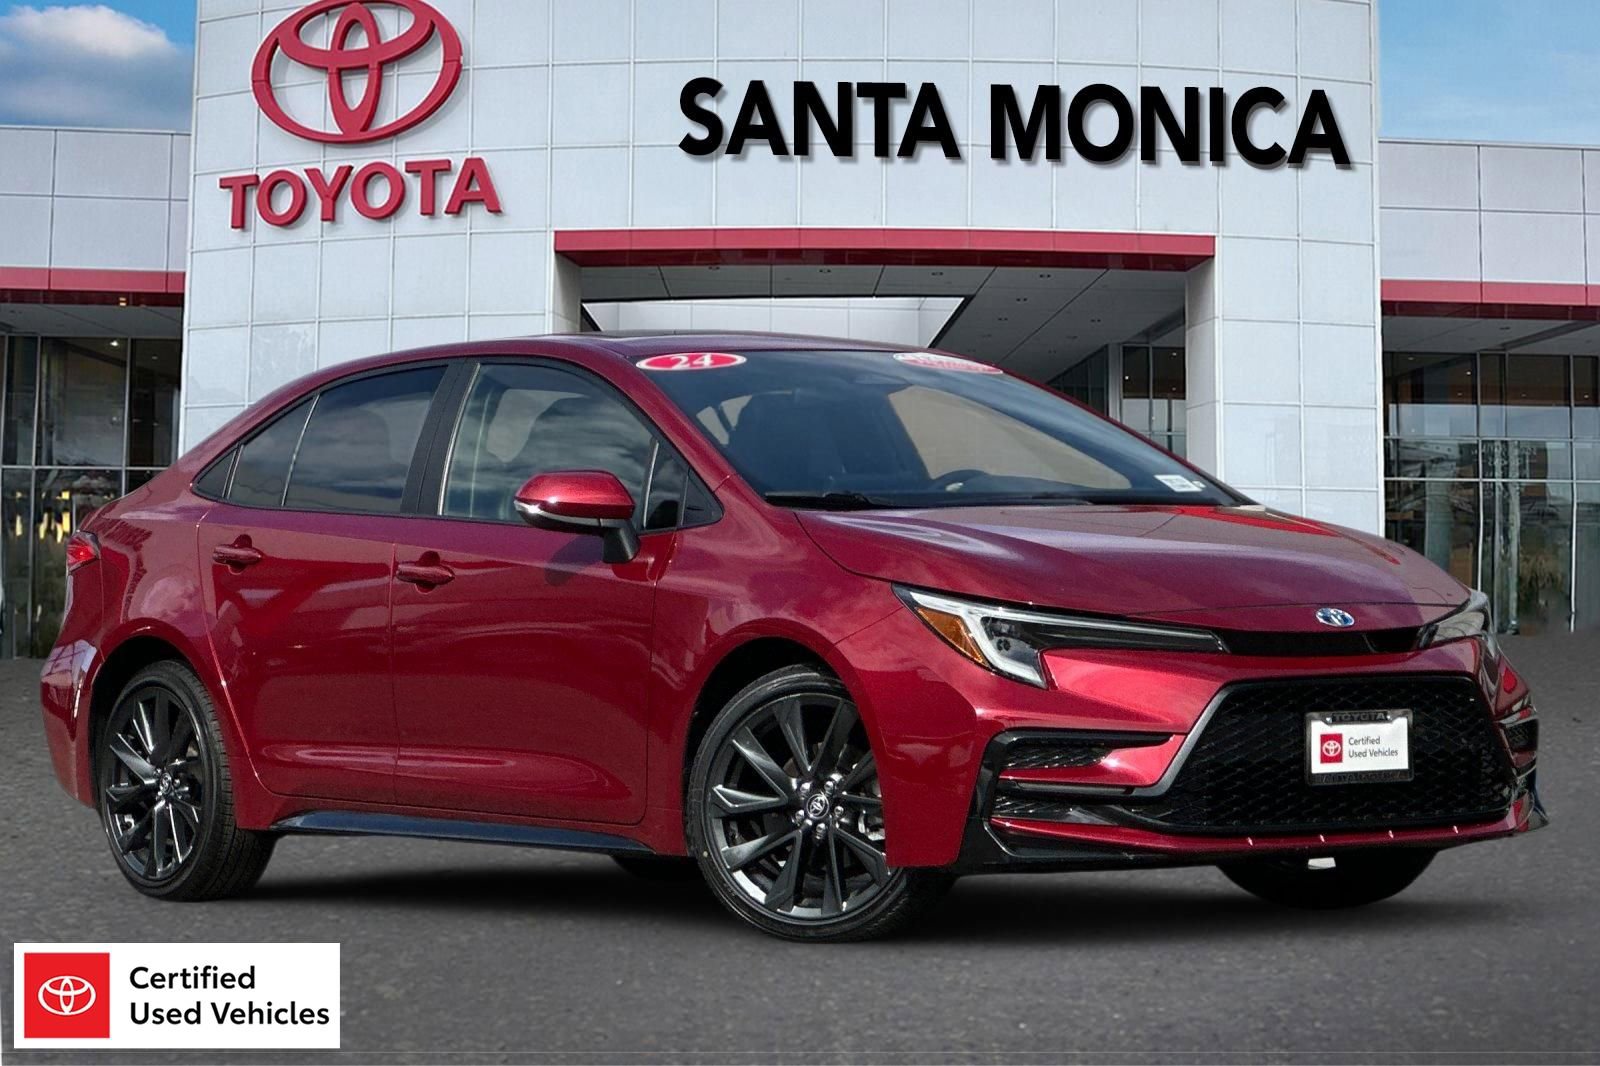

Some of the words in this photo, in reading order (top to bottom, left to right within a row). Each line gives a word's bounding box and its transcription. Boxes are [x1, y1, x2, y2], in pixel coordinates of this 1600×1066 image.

[679, 77, 960, 158] SANTA
[990, 84, 1351, 166] MONICA
[219, 157, 502, 229] TOYOTA
[670, 353, 714, 369] 24
[1333, 712, 1386, 721] TOYOTA
[1348, 736, 1381, 746] Certified
[1348, 749, 1368, 758] Used
[1369, 748, 1399, 758] Vehicles
